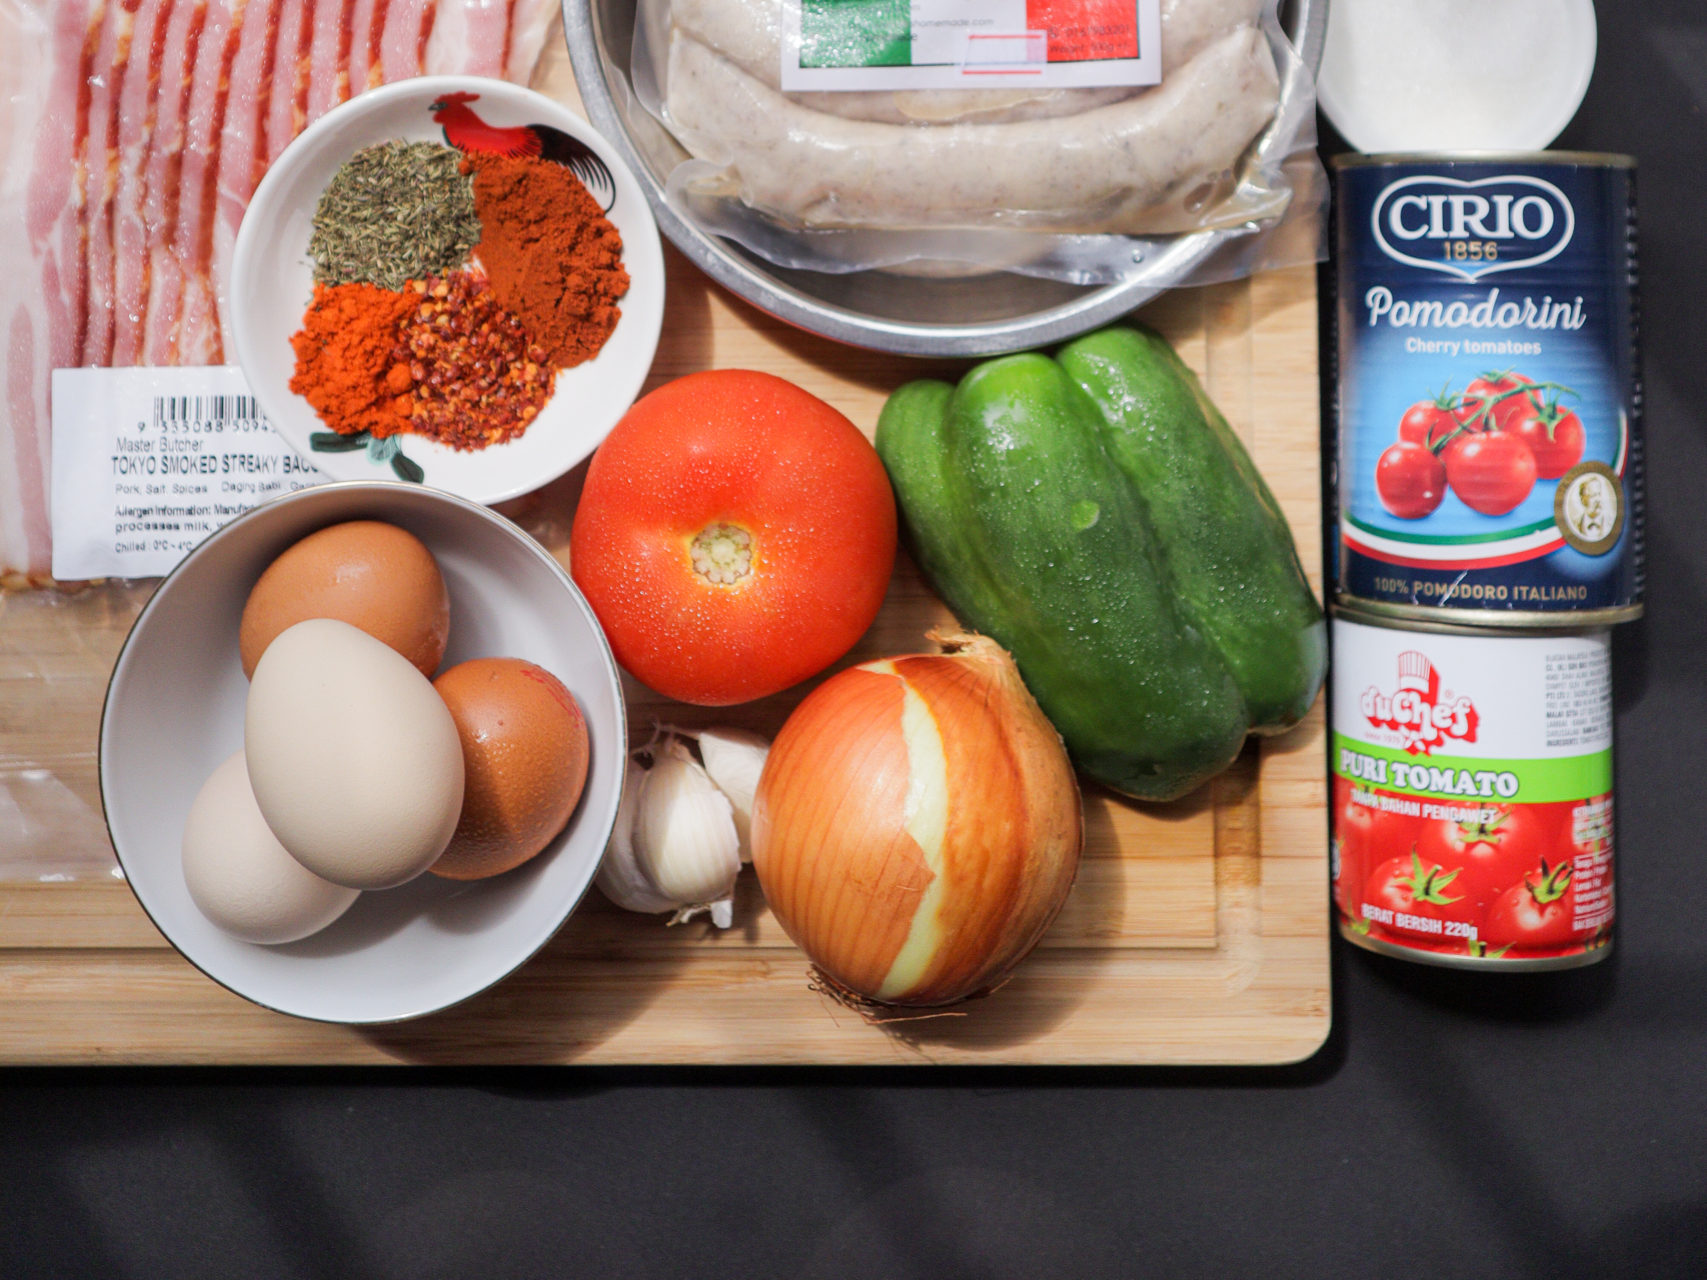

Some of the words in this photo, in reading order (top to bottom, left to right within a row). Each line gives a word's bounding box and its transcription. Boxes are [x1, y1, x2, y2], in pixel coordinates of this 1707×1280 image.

[1389, 194, 1554, 240] CIRIO
[1443, 240, 1498, 262] 1856
[1365, 286, 1587, 331] Pomodorini
[1406, 337, 1461, 357] Cherry
[1464, 338, 1542, 355] tomatoes
[116, 438, 155, 452] Master
[159, 436, 204, 452] Butcher
[112, 455, 156, 474] TOKYO
[161, 455, 218, 474] SMOKED
[222, 454, 279, 474] STREAKY
[115, 522, 180, 535] processes
[1374, 576, 1409, 594] 100%
[1412, 580, 1508, 601] POMODORO
[1513, 585, 1588, 601] ITALIANO
[1360, 686, 1474, 740] duChef
[1341, 747, 1388, 784] PURI
[1391, 761, 1519, 798] TOMATO
[1380, 797, 1421, 817] BAHAN
[1422, 803, 1497, 824] PENGAWET
[1361, 903, 1394, 922] BERAT
[1395, 912, 1442, 935] BERSIH
[1444, 920, 1479, 941] 220g
